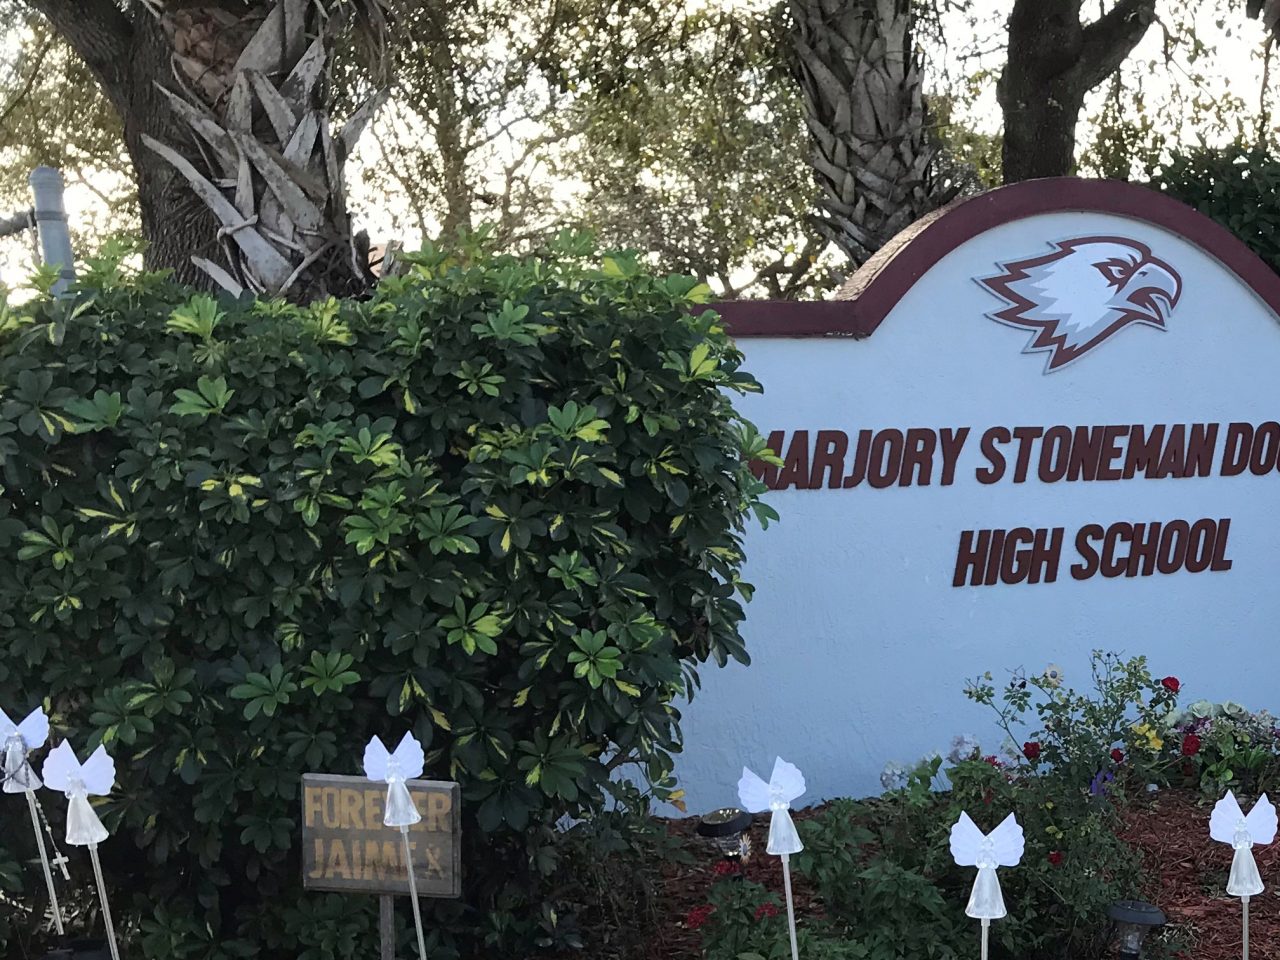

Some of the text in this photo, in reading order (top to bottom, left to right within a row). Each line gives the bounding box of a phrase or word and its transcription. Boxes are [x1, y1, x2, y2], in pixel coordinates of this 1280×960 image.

[975, 422, 1219, 486] STONEMAN
[952, 518, 1233, 587] HIGH SCHOOL
[304, 786, 453, 832] FOREER
